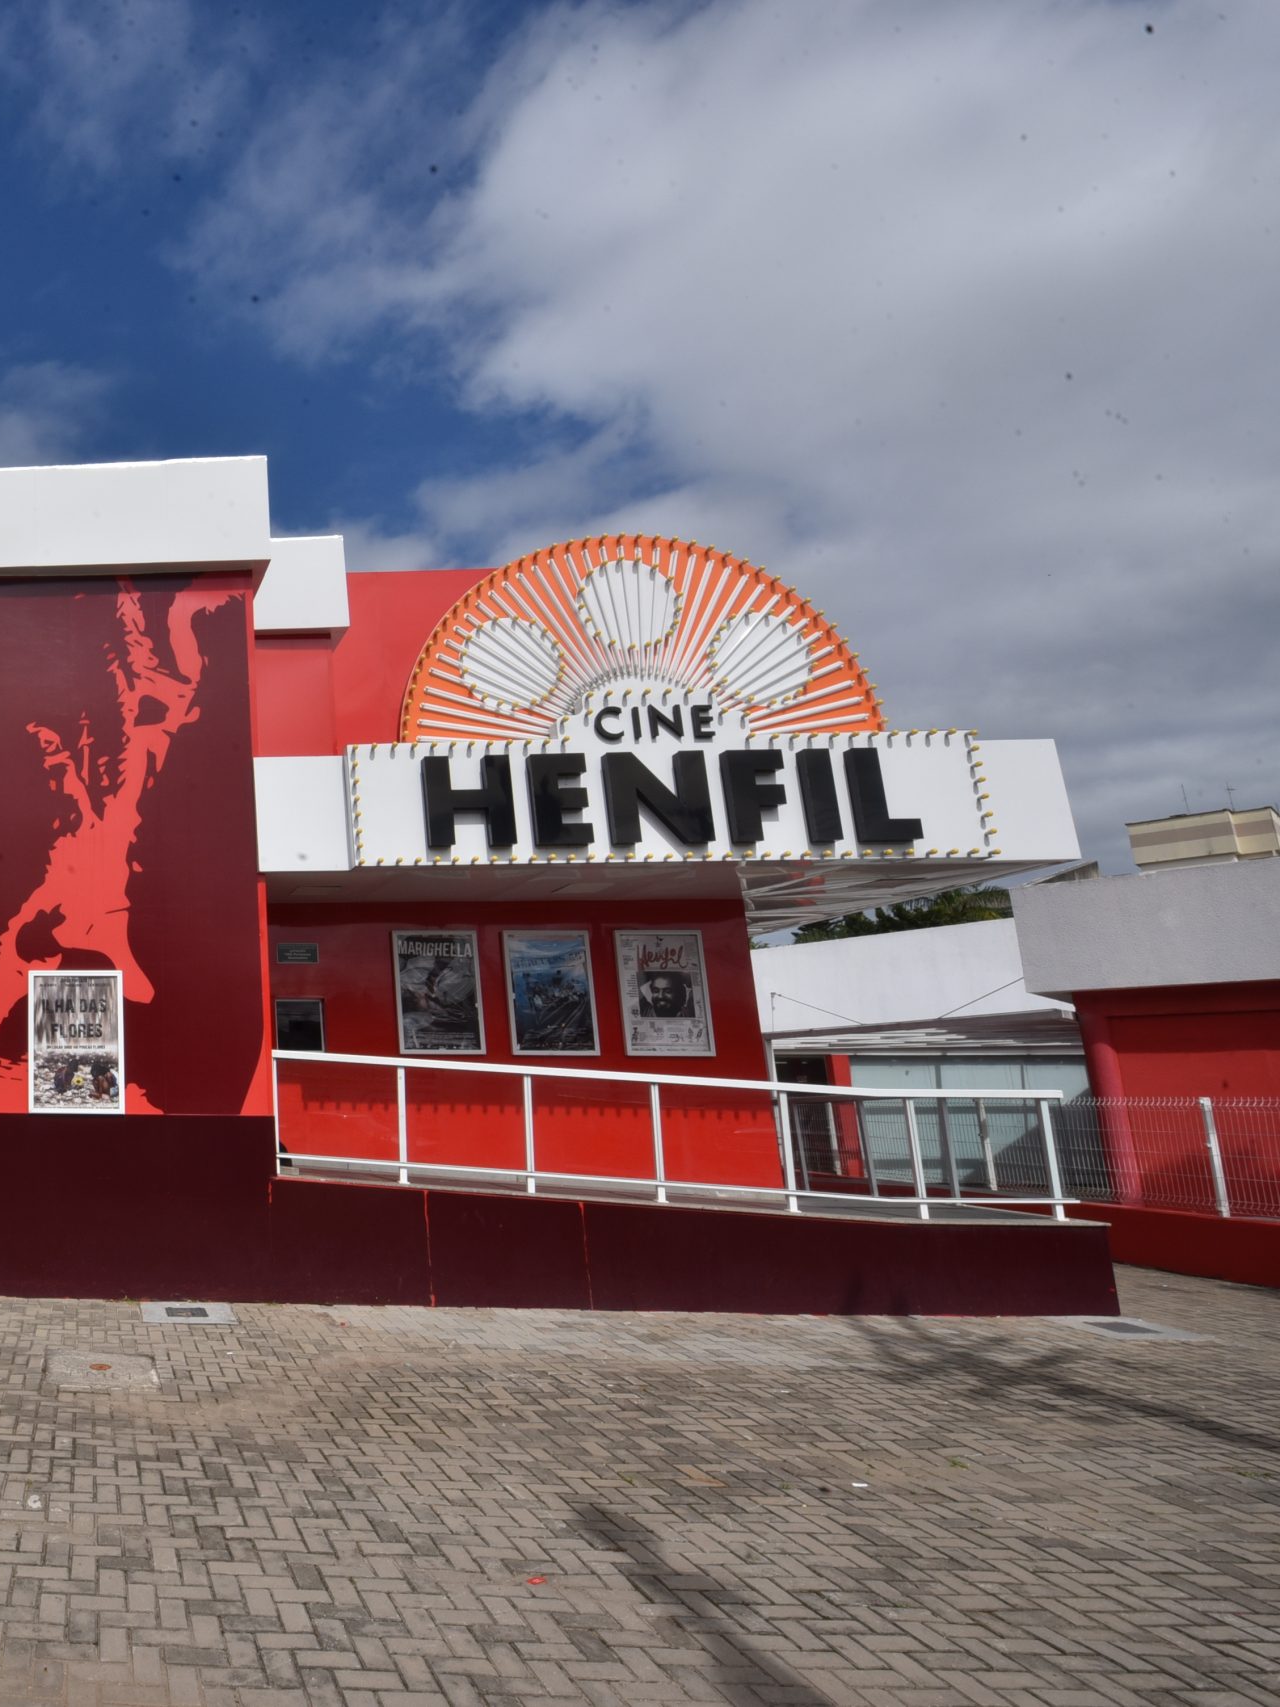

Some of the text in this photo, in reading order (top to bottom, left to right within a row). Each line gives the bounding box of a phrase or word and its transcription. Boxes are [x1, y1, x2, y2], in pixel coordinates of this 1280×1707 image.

[594, 703, 718, 744] CINE
[420, 747, 924, 847] HENFIL
[398, 940, 472, 957] MARIGHELLA
[79, 999, 107, 1013] DAS
[51, 1024, 103, 1038] FLORES
